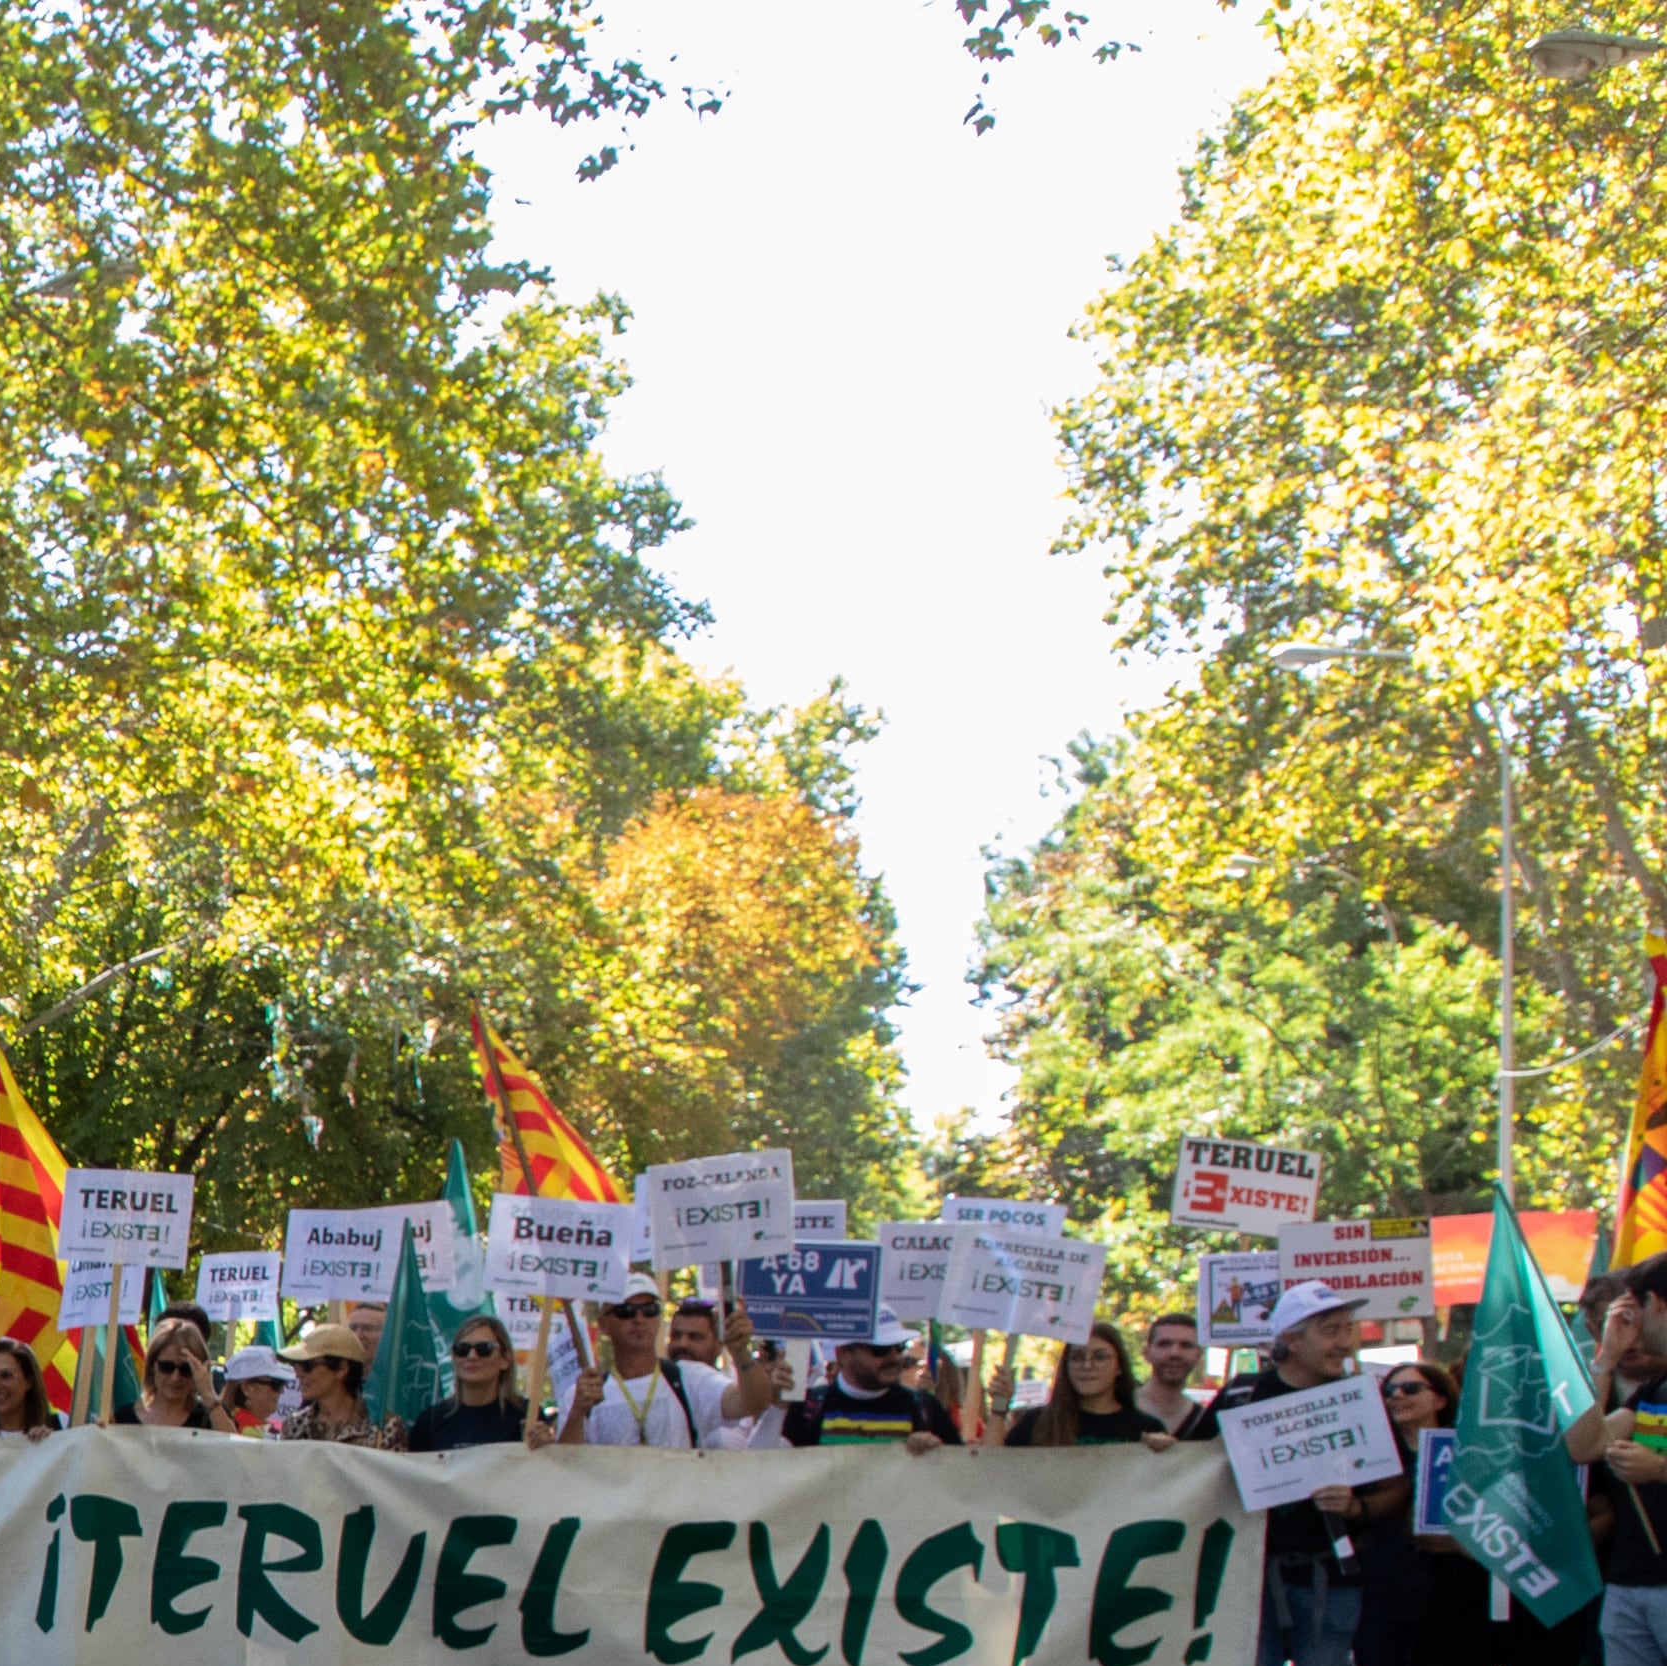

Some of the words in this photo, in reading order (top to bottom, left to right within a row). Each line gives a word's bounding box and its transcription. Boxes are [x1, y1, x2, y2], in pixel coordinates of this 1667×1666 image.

[1187, 1140, 1315, 1180] TERUEL
[662, 1165, 782, 1192] FOZ-CALANDA
[79, 1188, 179, 1214] TERUEL
[957, 1207, 985, 1221] SER
[989, 1209, 1047, 1226] POCOS
[307, 1227, 382, 1251] Ababuj
[514, 1215, 613, 1247] Bueña
[1334, 1225, 1365, 1241] SIN
[1069, 1252, 1090, 1265] DE
[209, 1264, 271, 1284] TERUEL
[899, 1261, 948, 1281] ¡EXIS
[71, 1279, 129, 1302] ¡EXIST!
[771, 1273, 807, 1295] YA
[1241, 1395, 1330, 1429] TORRECILLA
[1337, 1389, 1363, 1408] DE
[1273, 1411, 1340, 1438] ALCAÑIZ
[36, 1492, 589, 1657] ¡TERUEL
